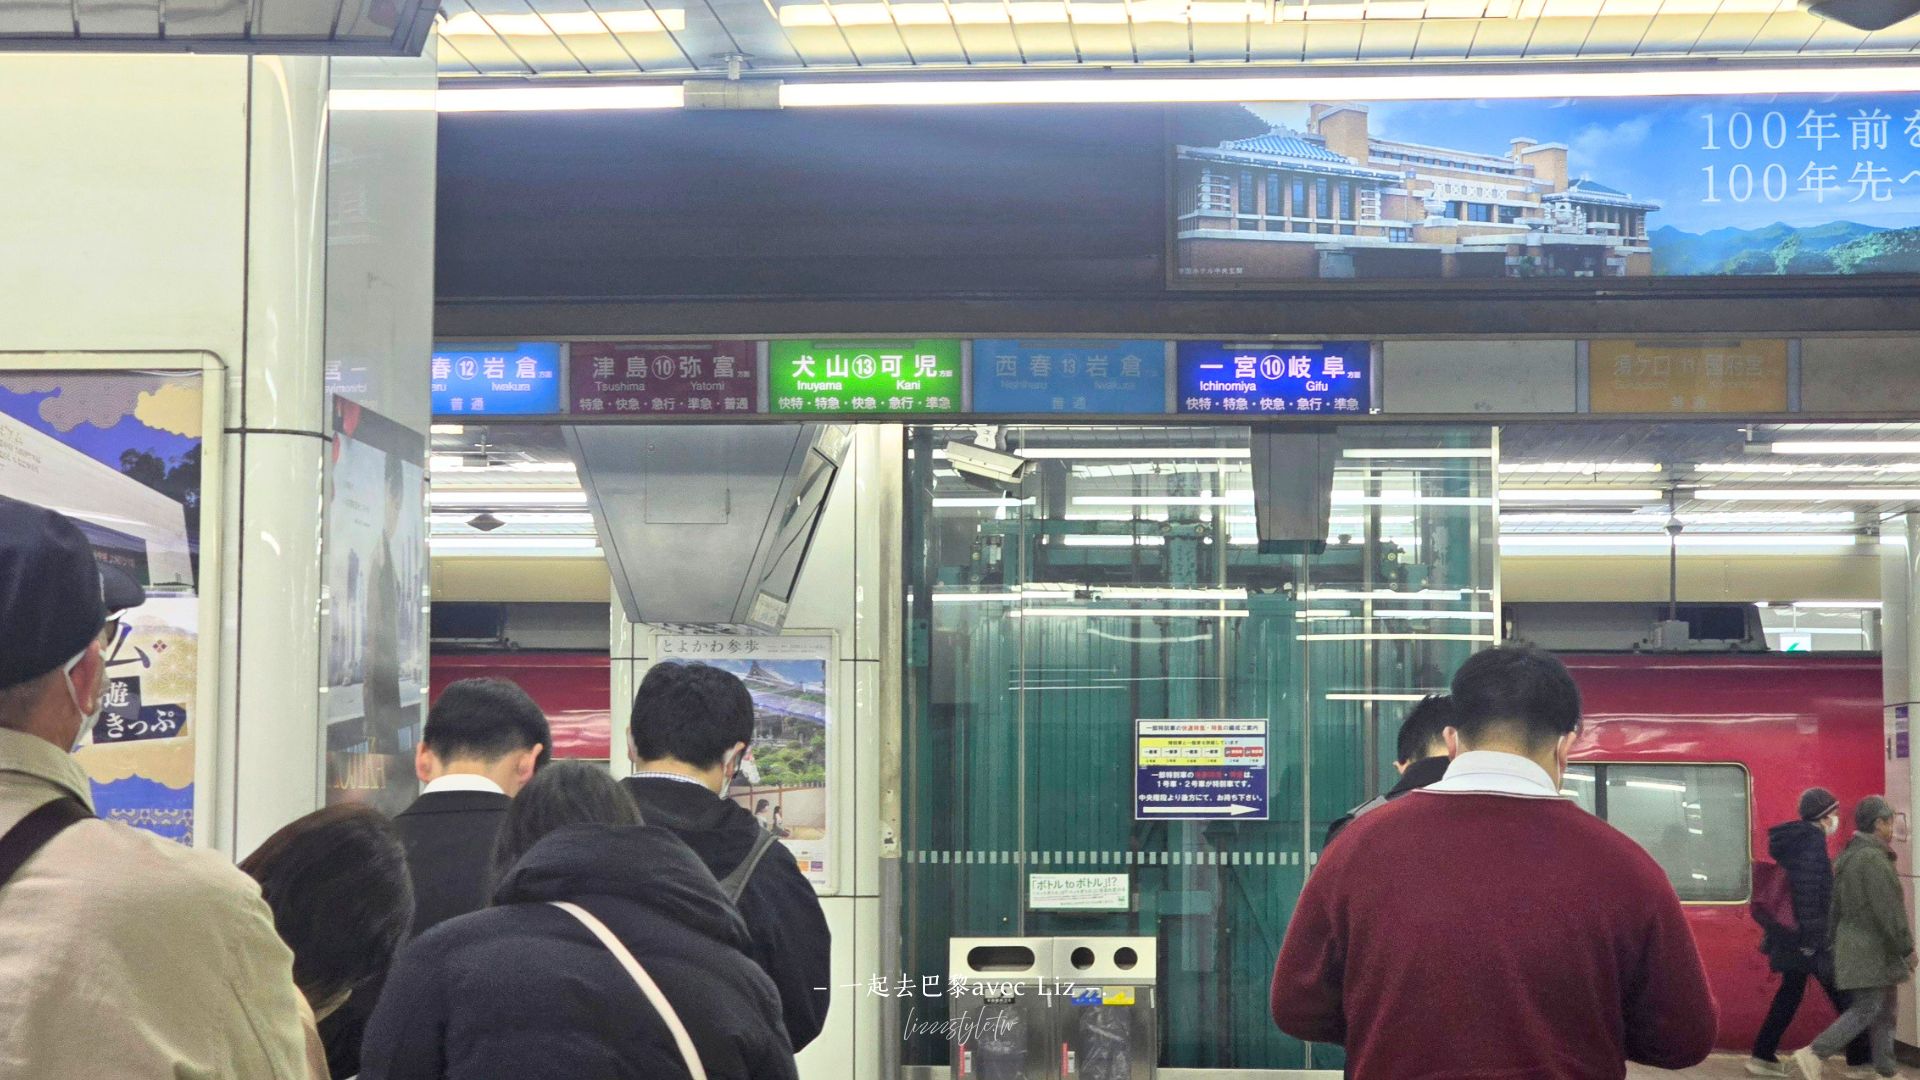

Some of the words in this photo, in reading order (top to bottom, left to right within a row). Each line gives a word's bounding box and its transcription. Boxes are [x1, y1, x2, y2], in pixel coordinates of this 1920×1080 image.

[483, 357, 537, 378] 岩倉
[592, 356, 647, 378] 津島
[679, 356, 734, 378] 弥富
[792, 355, 848, 377] 犬山
[880, 355, 937, 377] 可児
[996, 355, 1051, 376] 西春
[1086, 355, 1142, 377] 岩倉
[1200, 356, 1257, 378] 一宮
[1288, 356, 1345, 378] 岐阜
[596, 381, 645, 391] Tsushima
[690, 381, 725, 391] Yatomi
[797, 380, 842, 392] Inuyama
[896, 380, 920, 390] Kani
[1200, 381, 1257, 393] Ichinomiya
[1306, 381, 1328, 391] Gifu
[663, 639, 759, 653] とよかわ参歩
[106, 709, 176, 738] きっぷ
